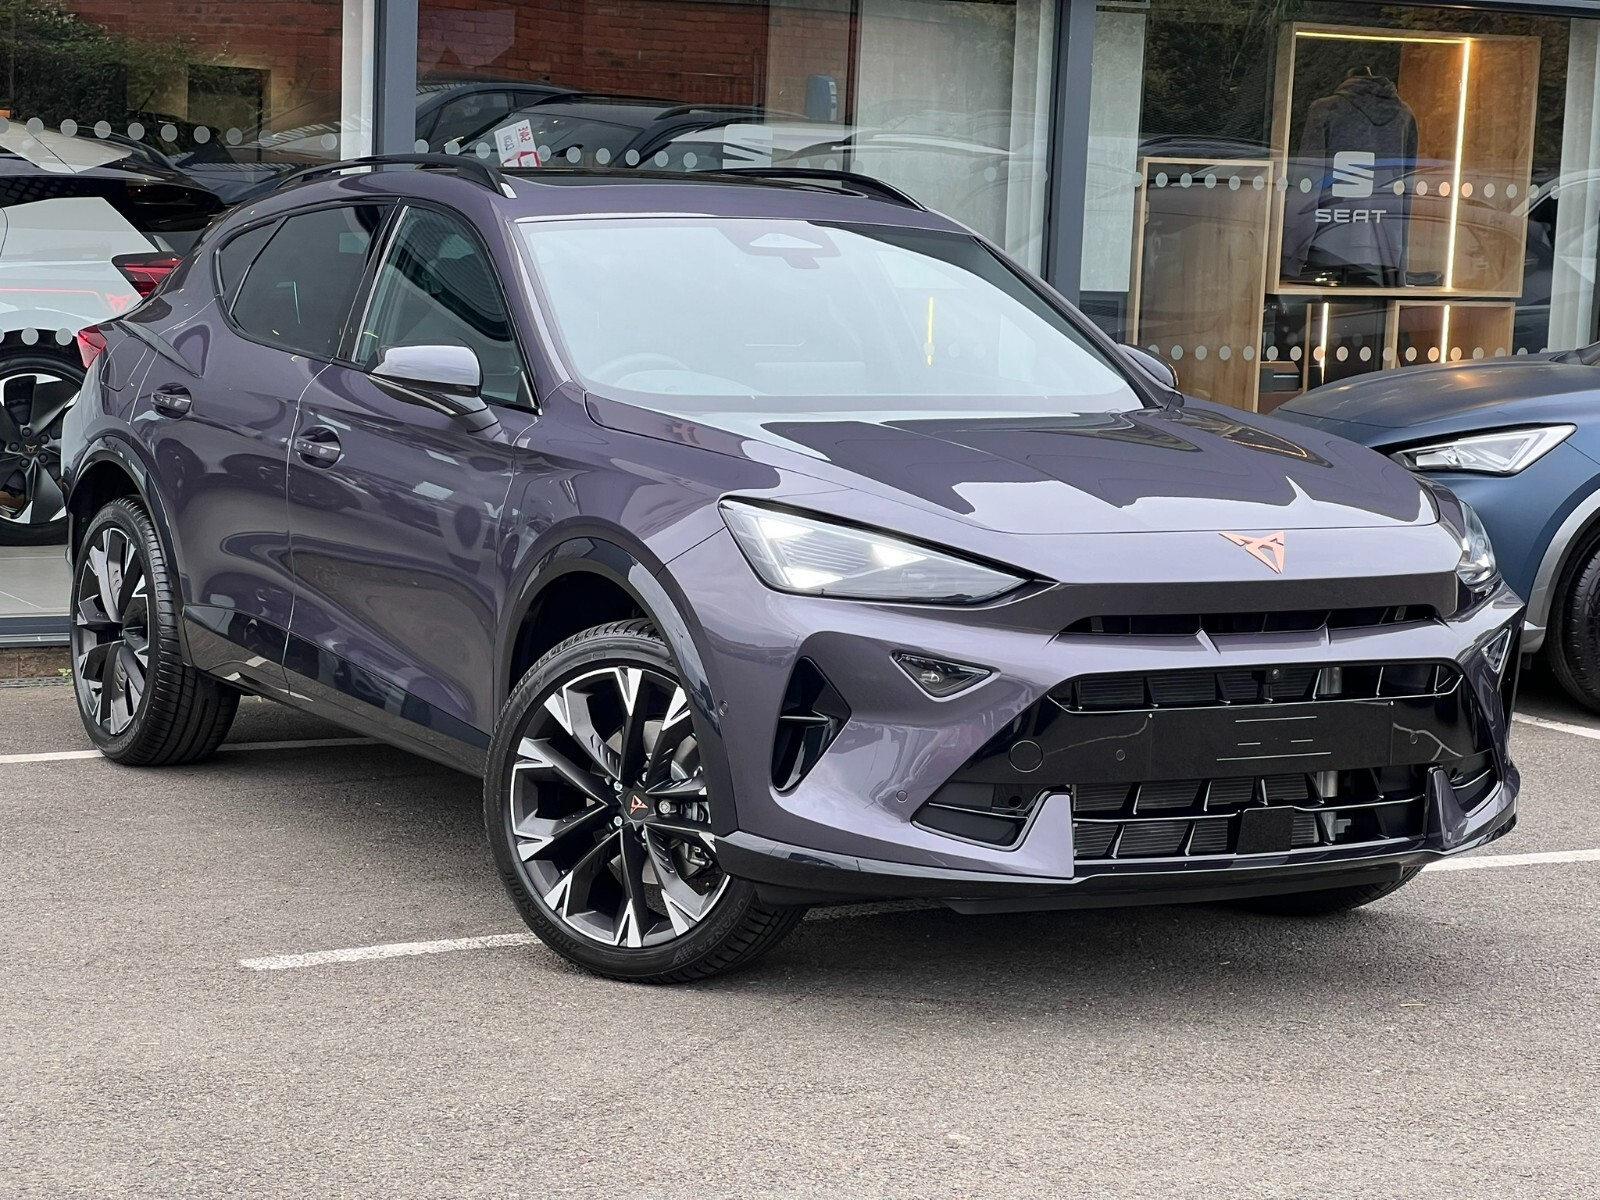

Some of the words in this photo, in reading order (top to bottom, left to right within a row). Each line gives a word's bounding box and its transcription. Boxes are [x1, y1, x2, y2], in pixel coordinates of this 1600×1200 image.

[1315, 209, 1387, 223] SEAT
[503, 868, 580, 954] BRIDGESTONE
[697, 893, 749, 952] URANZA
